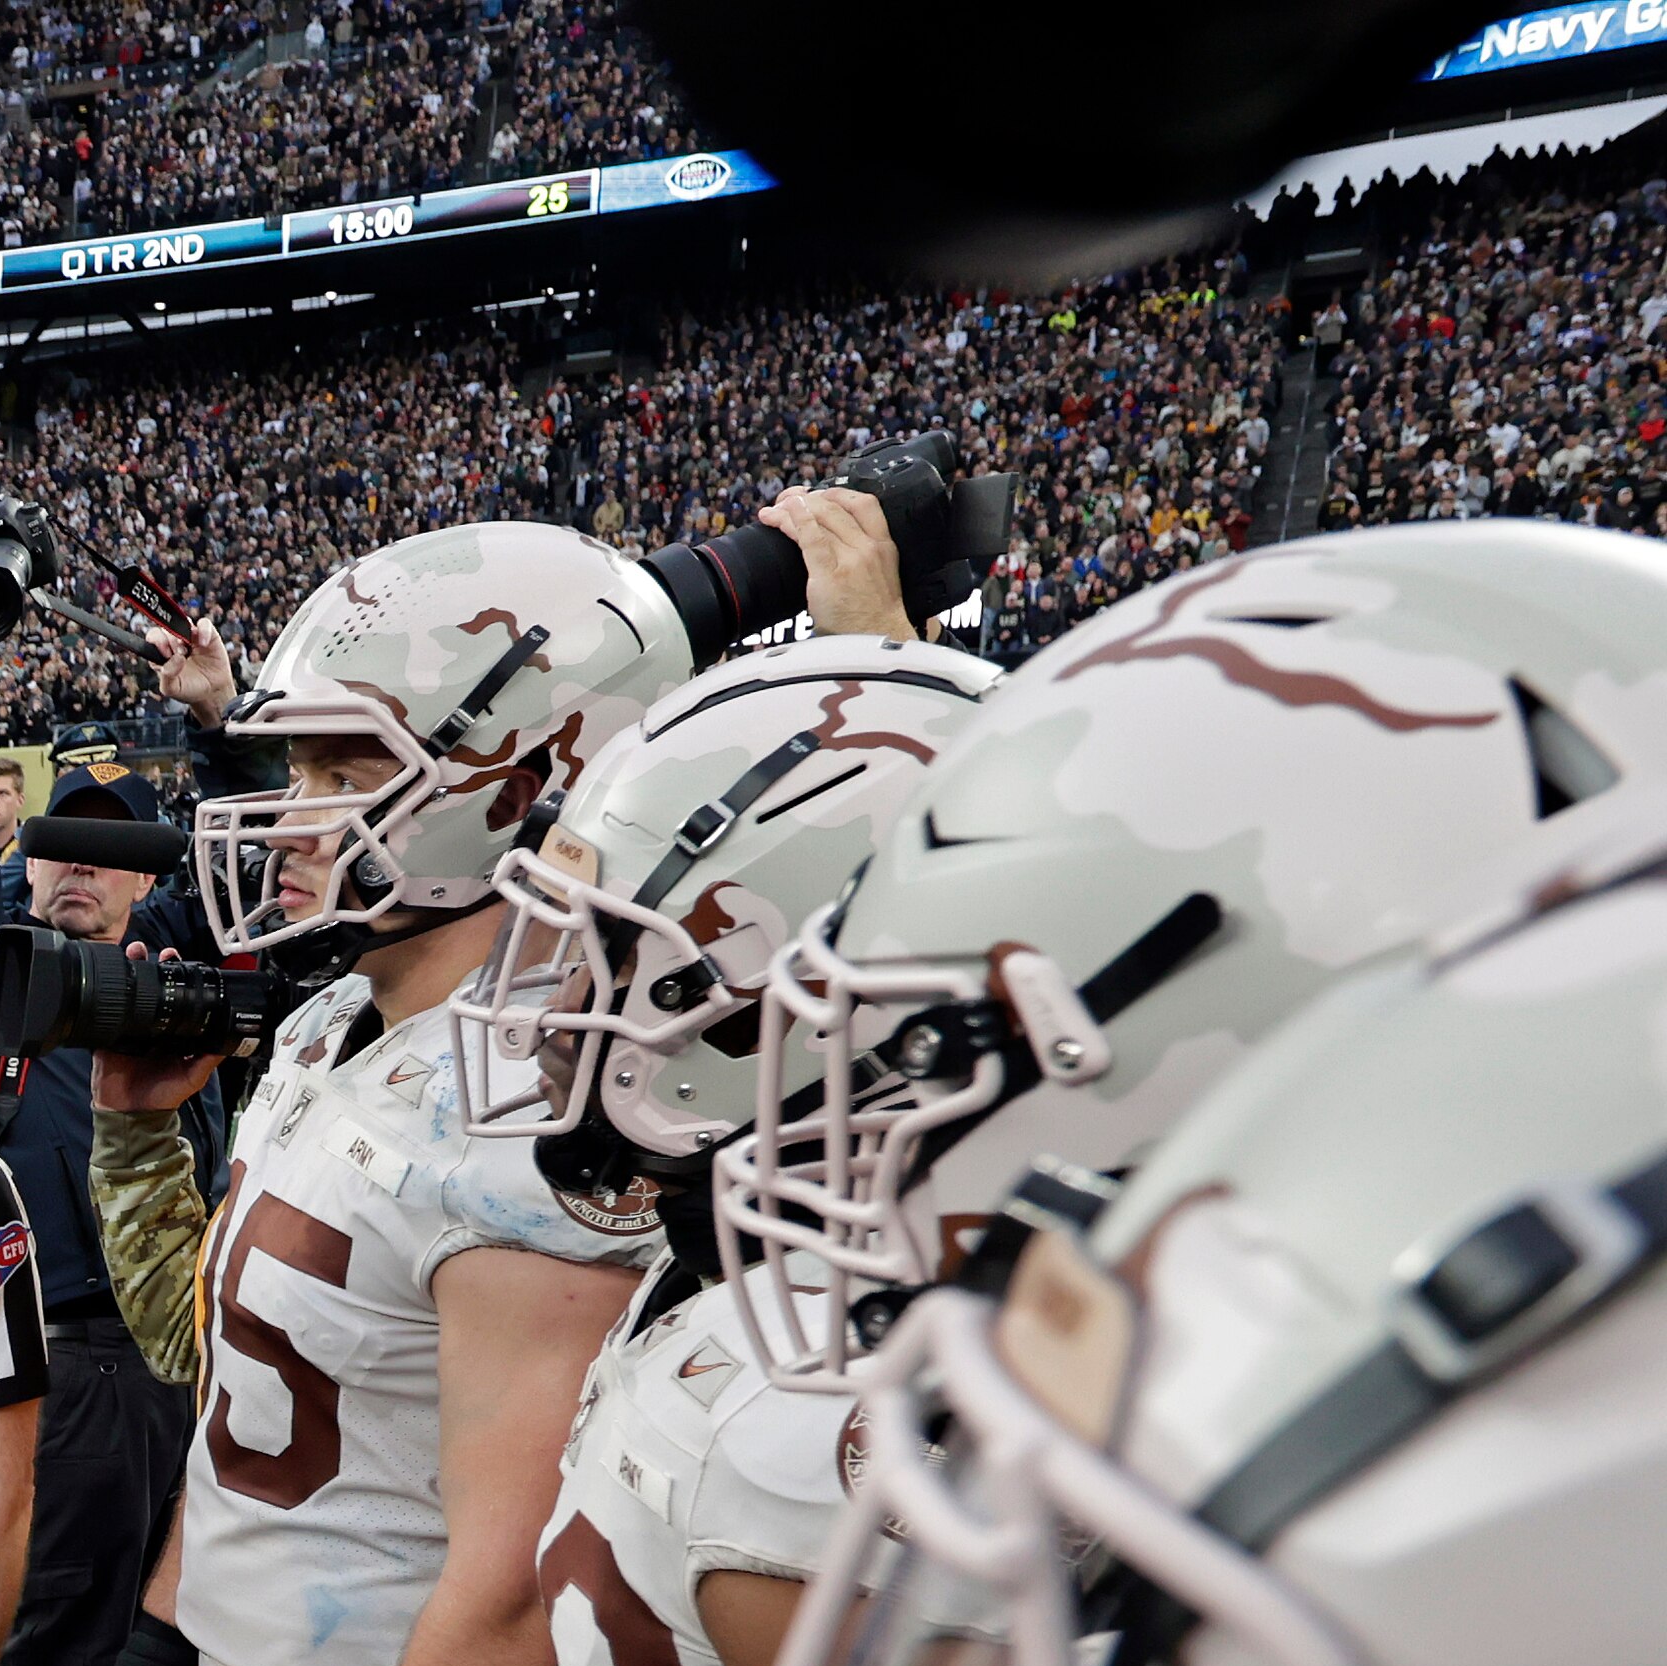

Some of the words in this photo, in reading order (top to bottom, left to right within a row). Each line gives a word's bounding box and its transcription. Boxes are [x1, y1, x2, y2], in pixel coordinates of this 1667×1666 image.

[527, 183, 568, 216] 25
[328, 205, 413, 244] 15:00
[62, 244, 136, 281] QTR
[143, 234, 205, 268] 2ND
[346, 1136, 377, 1171] ARMY
[2, 1240, 26, 1260] CFO
